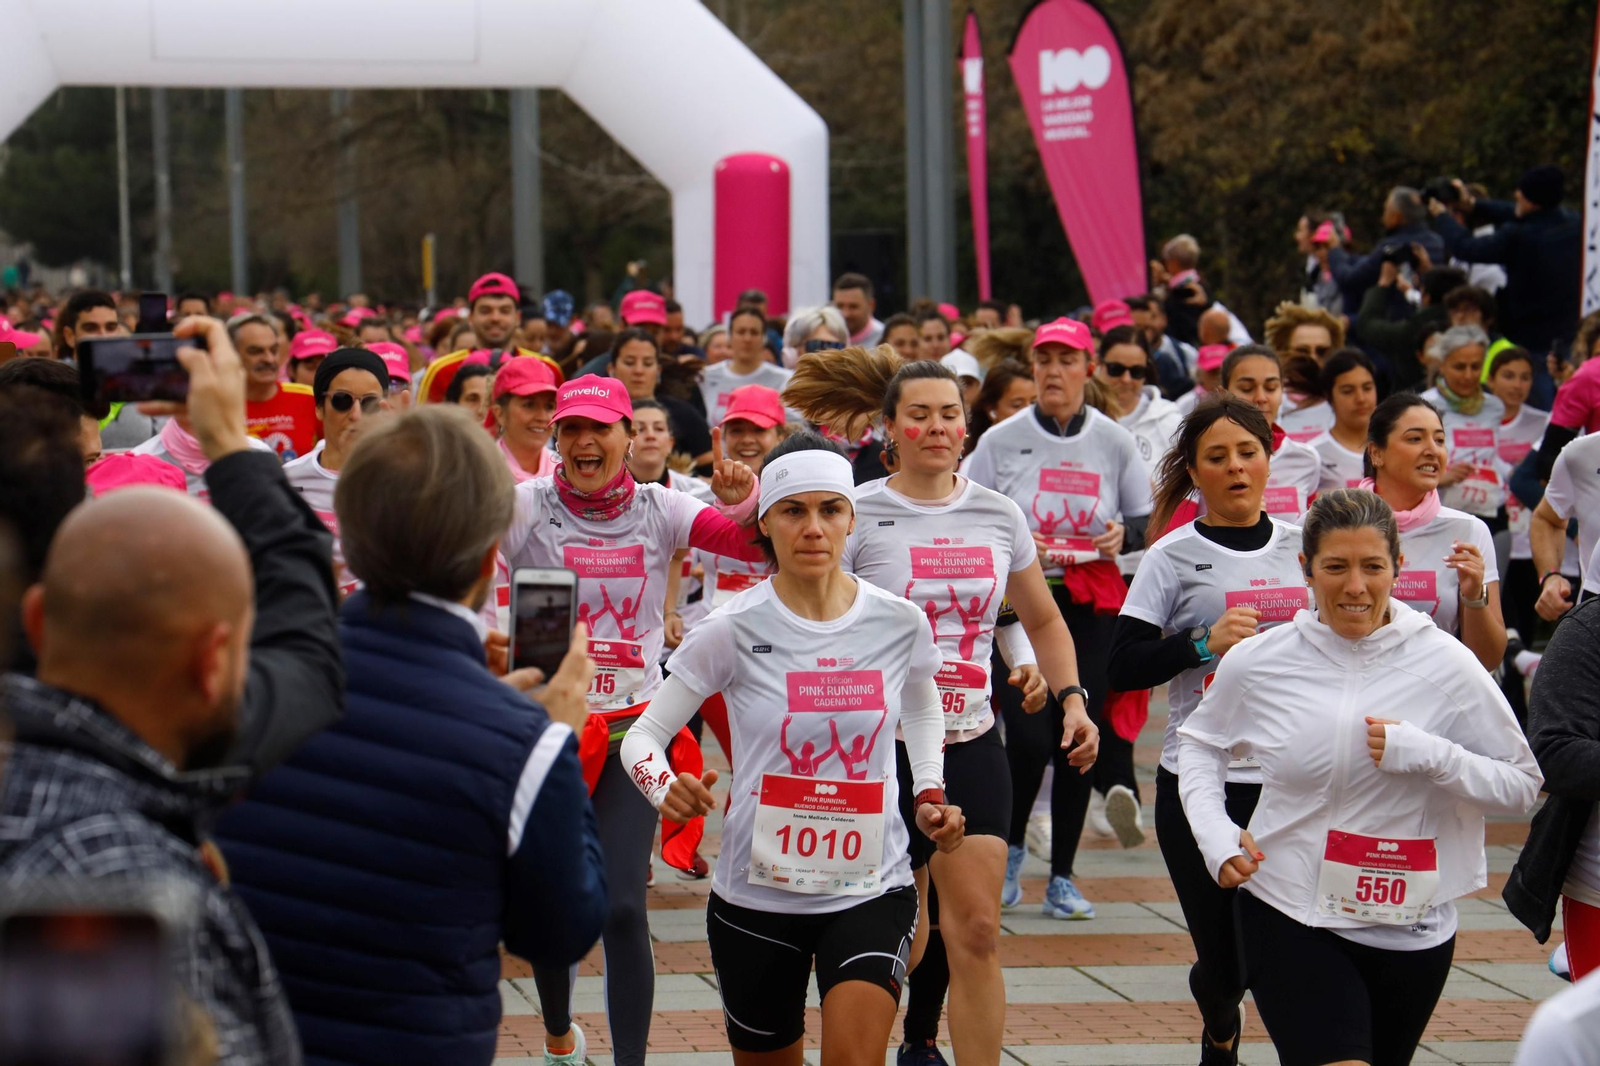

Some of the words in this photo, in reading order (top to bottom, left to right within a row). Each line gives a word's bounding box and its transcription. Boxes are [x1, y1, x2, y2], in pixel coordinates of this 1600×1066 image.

[1039, 45, 1111, 95] 100
[1461, 485, 1488, 504] 773
[574, 557, 595, 565] PINK
[597, 556, 637, 565] RUNNING
[921, 558, 942, 567] PINK
[944, 557, 986, 566] RUNNING
[586, 566, 613, 574] CADENA
[1261, 599, 1302, 609] RUNNING
[827, 676, 853, 685] Edición
[799, 685, 825, 696] PINK
[827, 685, 875, 696] RUNNING
[814, 698, 846, 706] CADENA
[848, 697, 862, 706] 100
[939, 692, 966, 714] 95
[819, 797, 847, 805] RUNNING
[776, 824, 862, 861] 1010
[1381, 853, 1407, 861] RUNNING
[1355, 875, 1407, 905] 550
